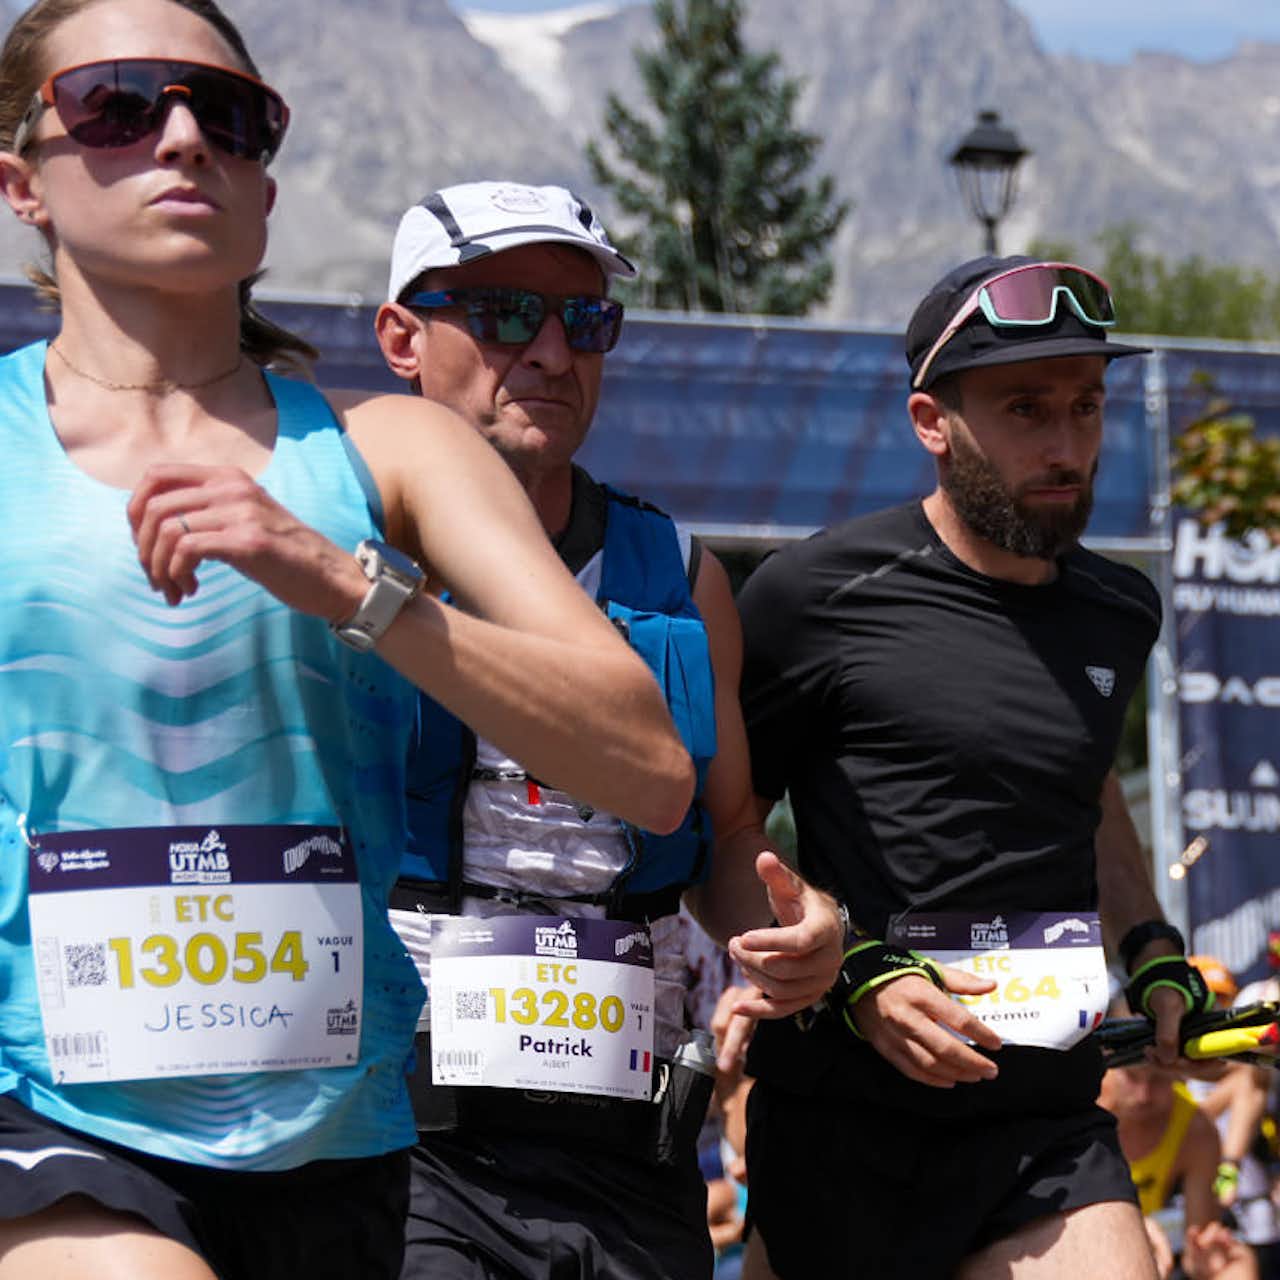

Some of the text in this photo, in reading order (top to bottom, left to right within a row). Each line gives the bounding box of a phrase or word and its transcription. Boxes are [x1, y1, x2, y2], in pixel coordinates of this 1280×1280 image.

[169, 851, 230, 871] UTMB
[174, 894, 235, 923] ETC
[317, 936, 354, 946] VAGUE
[535, 934, 578, 949] UTMB
[971, 929, 1009, 942] UTMB
[107, 930, 310, 989] 13054
[331, 951, 340, 973] 1
[973, 956, 1011, 973] ETC
[536, 963, 578, 985] ETC
[144, 1003, 294, 1033] JESSICA
[327, 1014, 358, 1028] UTMB
[489, 987, 626, 1033] 13280
[519, 1035, 593, 1058] Patrick
